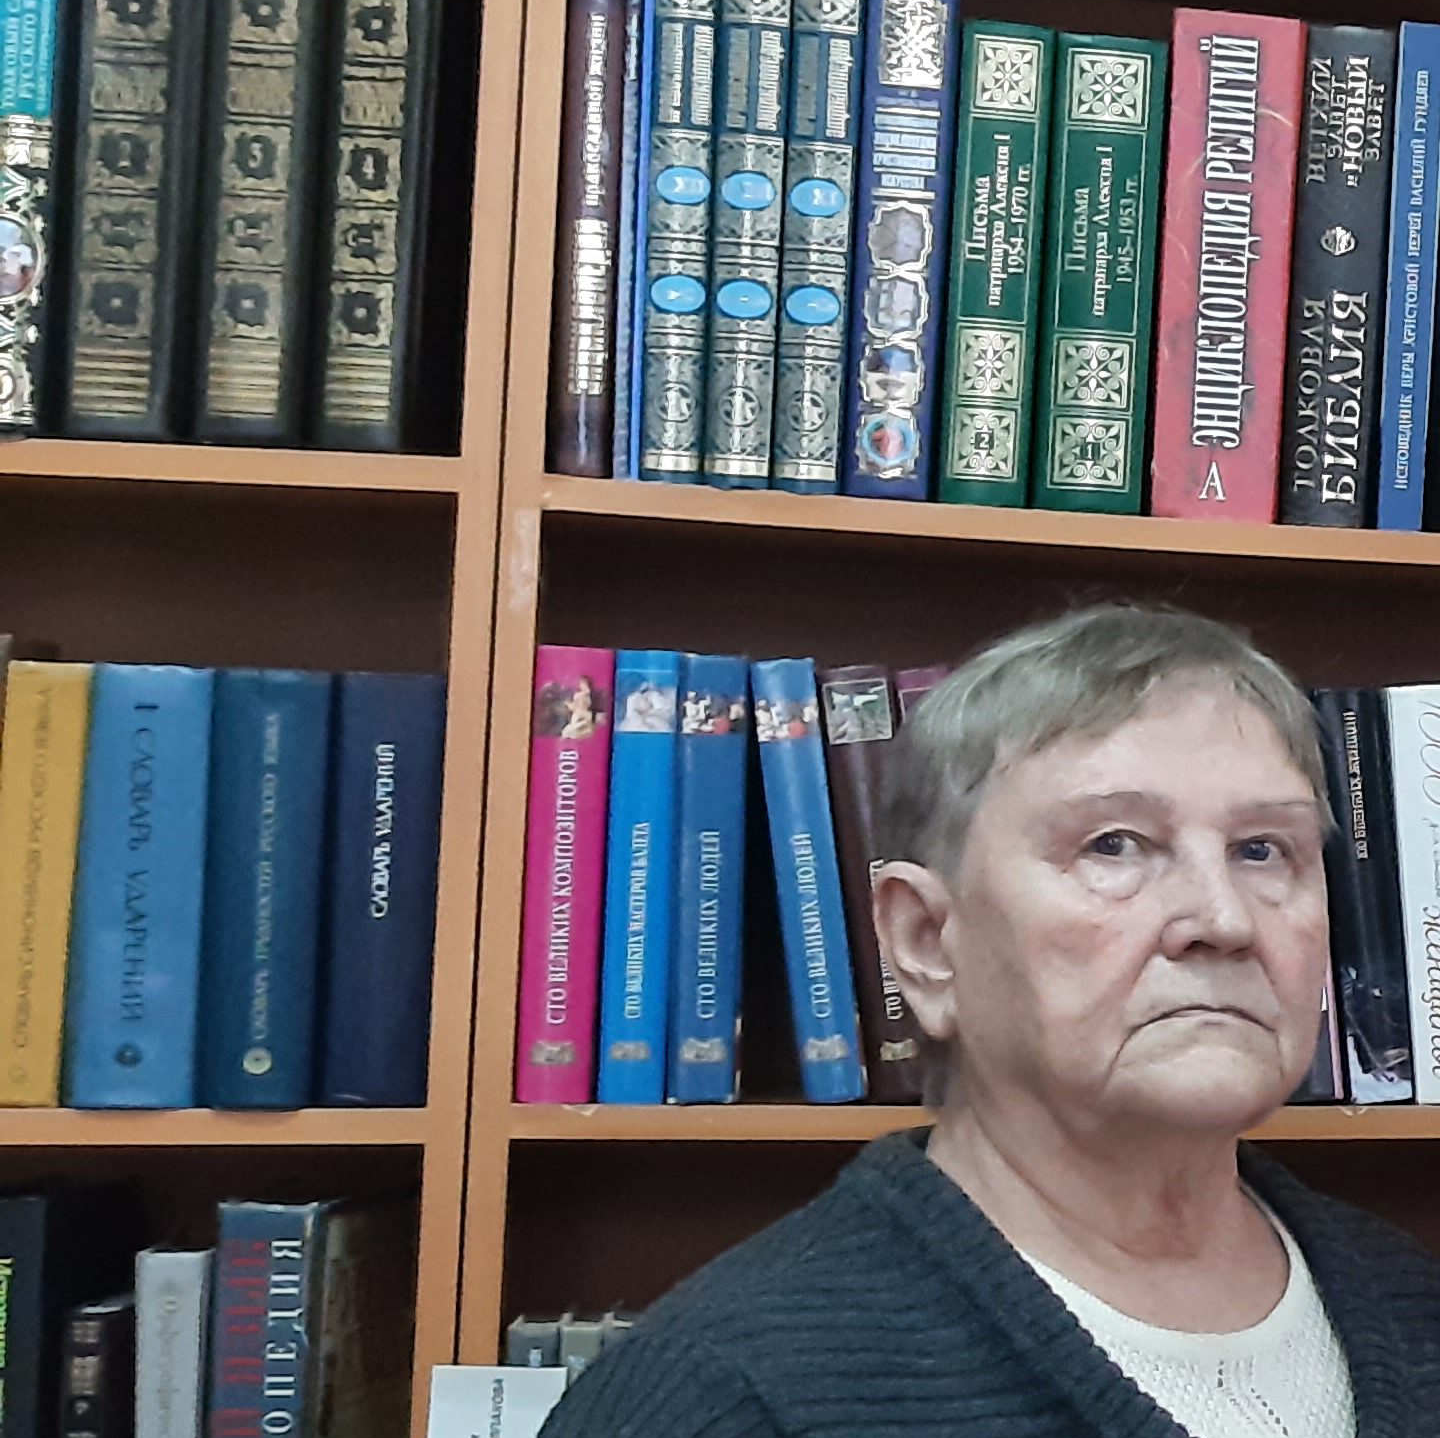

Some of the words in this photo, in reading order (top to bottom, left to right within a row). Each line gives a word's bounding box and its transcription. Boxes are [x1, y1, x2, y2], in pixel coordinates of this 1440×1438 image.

[1200, 35, 1260, 184] РЕЛИГИЙ
[1305, 56, 1333, 183] ВЕТХИЙ
[1326, 78, 1347, 158] ЗАВЕТ
[1341, 55, 1370, 174] НОВЫЙ
[1364, 81, 1387, 161] ЗАВЕТ
[1413, 69, 1429, 132] ГУНДЯЕВ
[1409, 138, 1427, 205] ВАСИЛИЙ
[1192, 188, 1262, 449] ЭНЦИКЛОПЕДИЯ
[1401, 264, 1421, 347] ХРИСТОВОЙ
[1292, 298, 1327, 492] ТОЛКОВАЯ
[1321, 291, 1369, 506] БИБЛИЯ
[1199, 462, 1226, 501] А
[128, 727, 156, 851] СЛОВАРЬ
[375, 743, 396, 837] УДАРЕНИЙ
[552, 749, 580, 897] КОМПОЗИТОРОВ
[370, 842, 391, 919] СЛОВАРЬ
[700, 831, 720, 893] ЛЮДЕЙ
[792, 833, 818, 894] ЛЮДЕЙ
[121, 869, 150, 1021] УДАРЕНИЙ
[549, 902, 571, 982] ВЕЛИКИХ
[698, 899, 719, 978] ВЕЛИКИХ
[801, 900, 827, 978] ВЕЛИКИХ
[546, 988, 566, 1024] СТО
[696, 984, 716, 1019] СТО
[810, 984, 832, 1019] СТО
